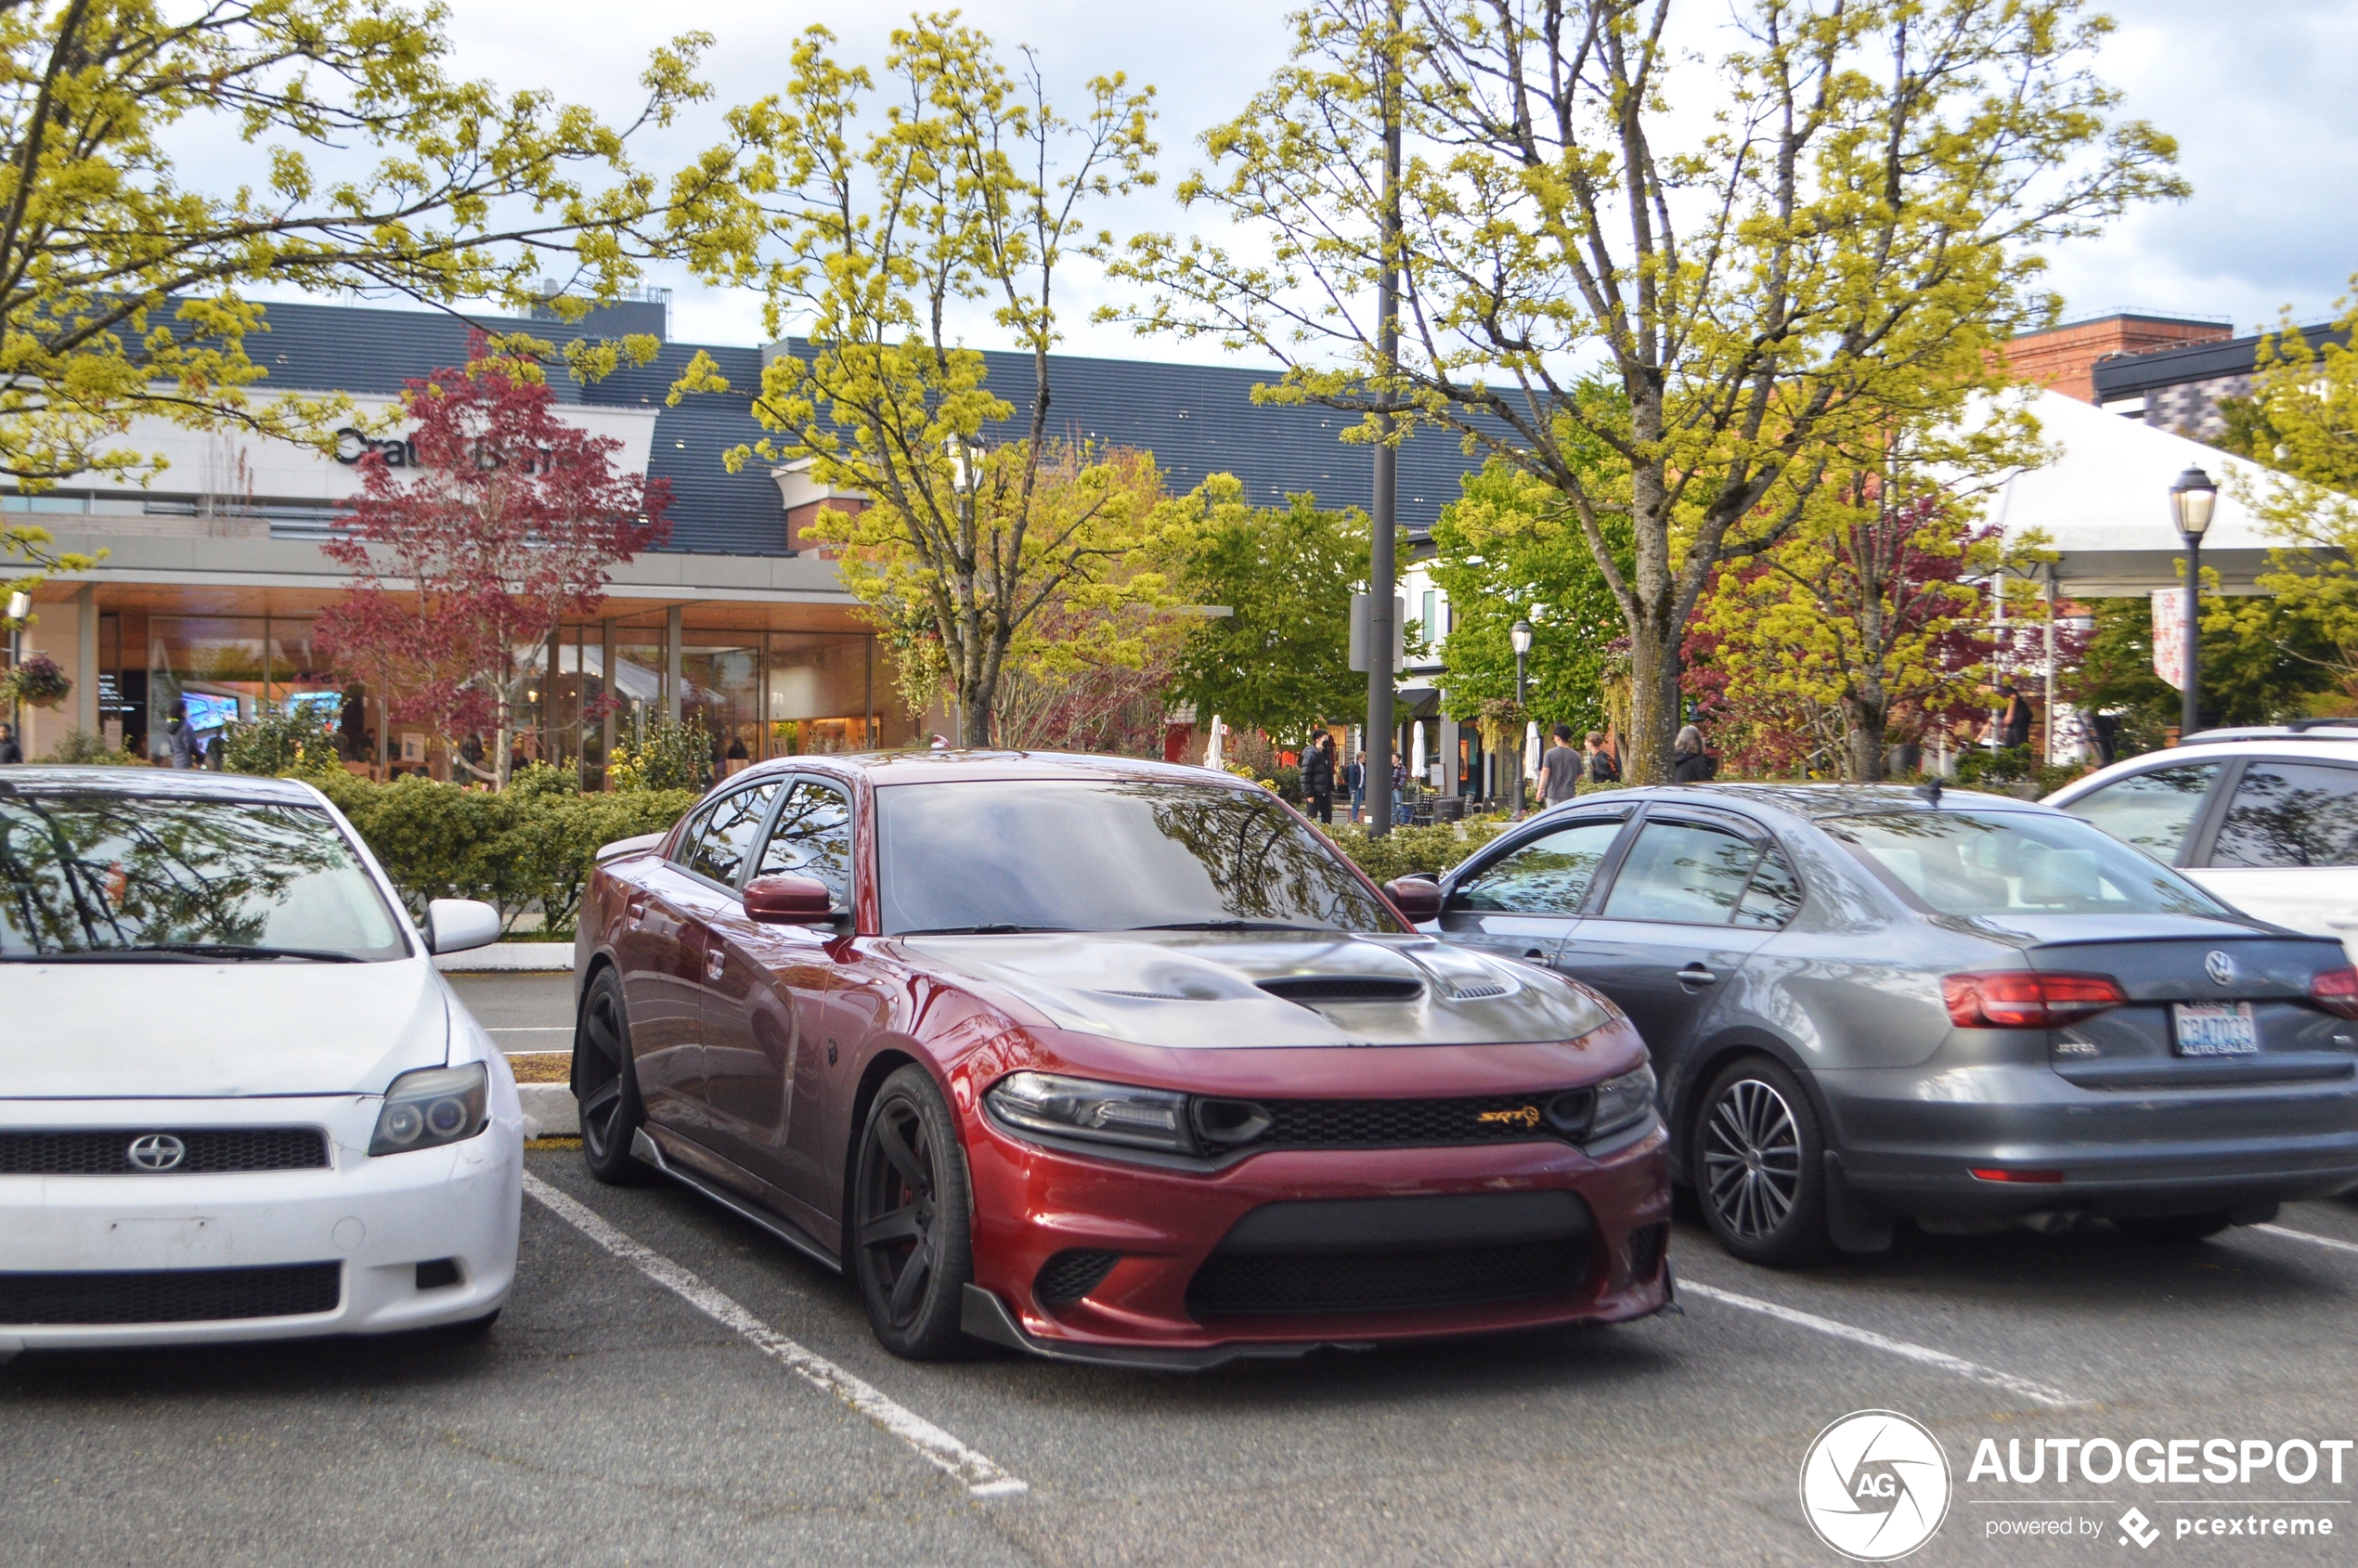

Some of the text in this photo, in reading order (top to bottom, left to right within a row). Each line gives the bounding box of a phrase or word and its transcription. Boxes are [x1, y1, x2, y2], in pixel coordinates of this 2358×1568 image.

[2182, 1043, 2259, 1056] AUTO SALES
[1477, 1110, 1526, 1124] SRT
